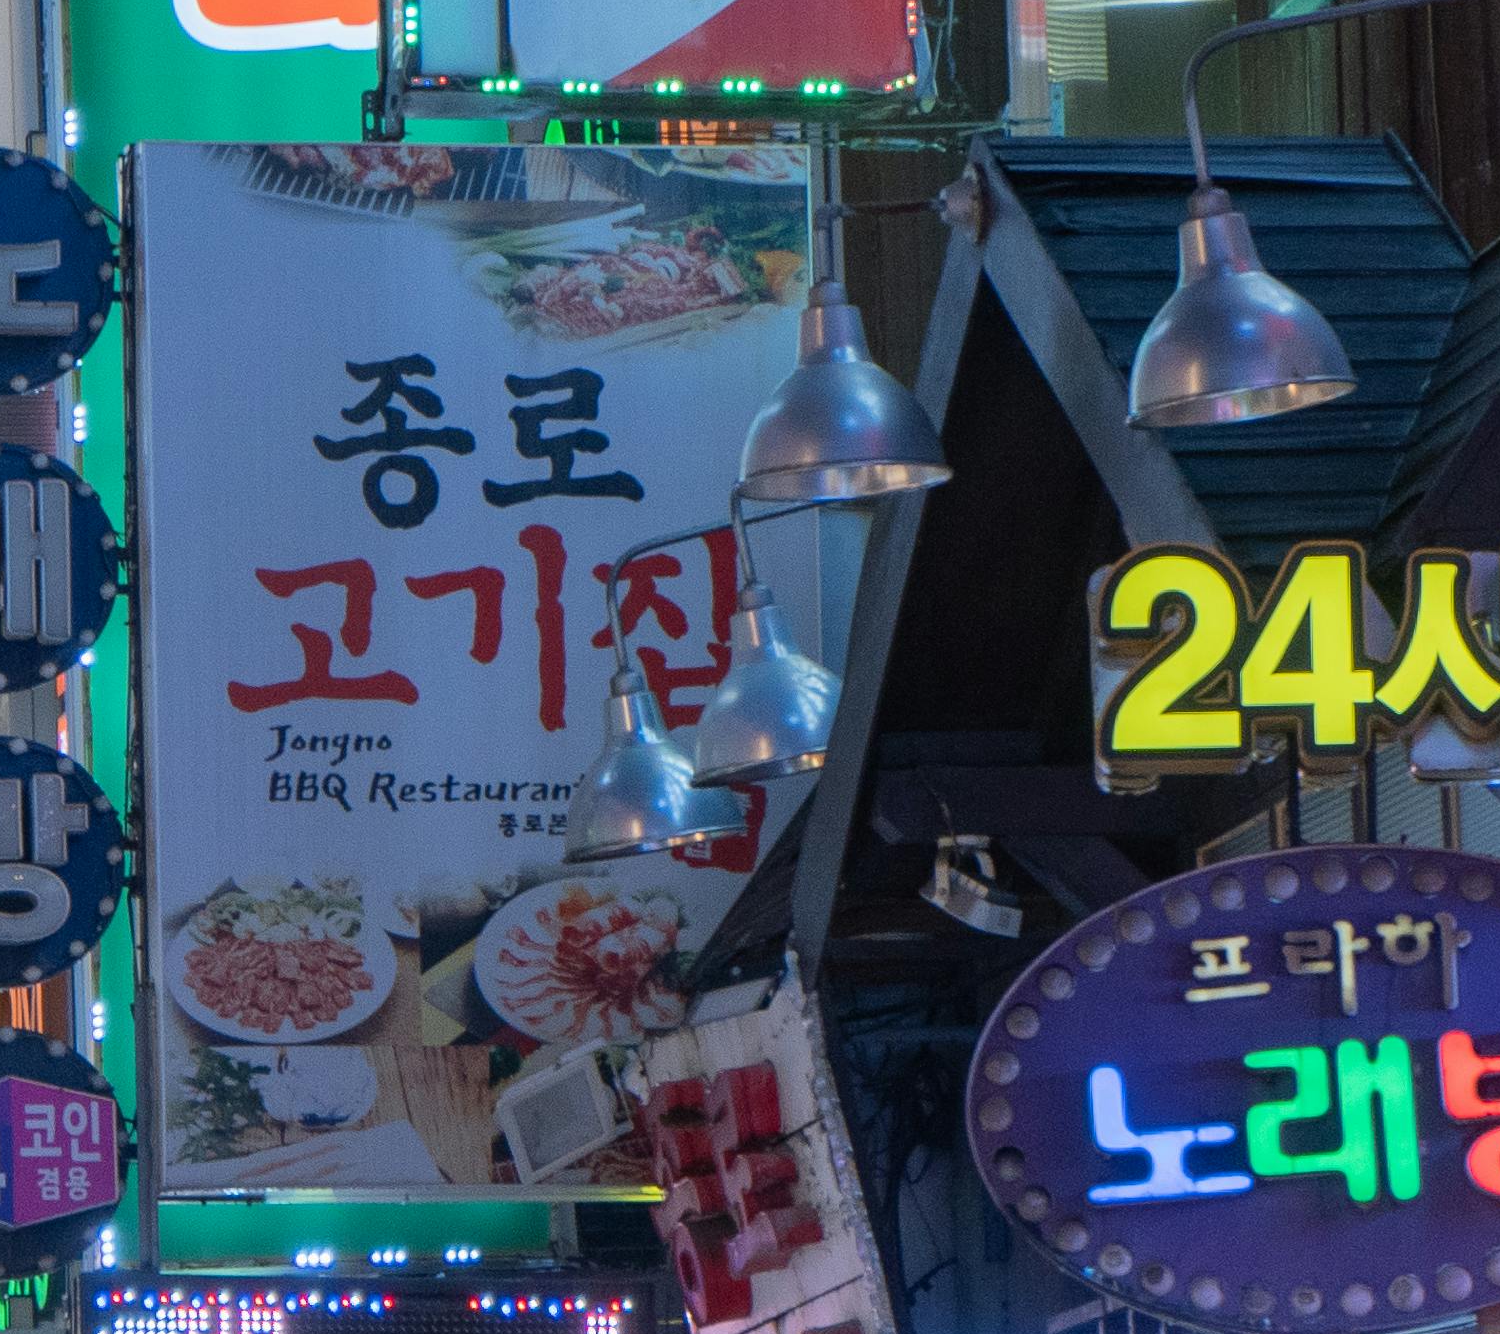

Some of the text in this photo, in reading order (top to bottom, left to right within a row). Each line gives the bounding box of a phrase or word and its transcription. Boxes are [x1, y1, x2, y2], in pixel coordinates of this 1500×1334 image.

[313, 352, 645, 532] 종로
[264, 723, 394, 766] Jongno
[268, 770, 354, 813] BBQ
[1184, 911, 1472, 1017] 프라하
[17, 1097, 104, 1162] 코인
[36, 1163, 93, 1206] 겸용
